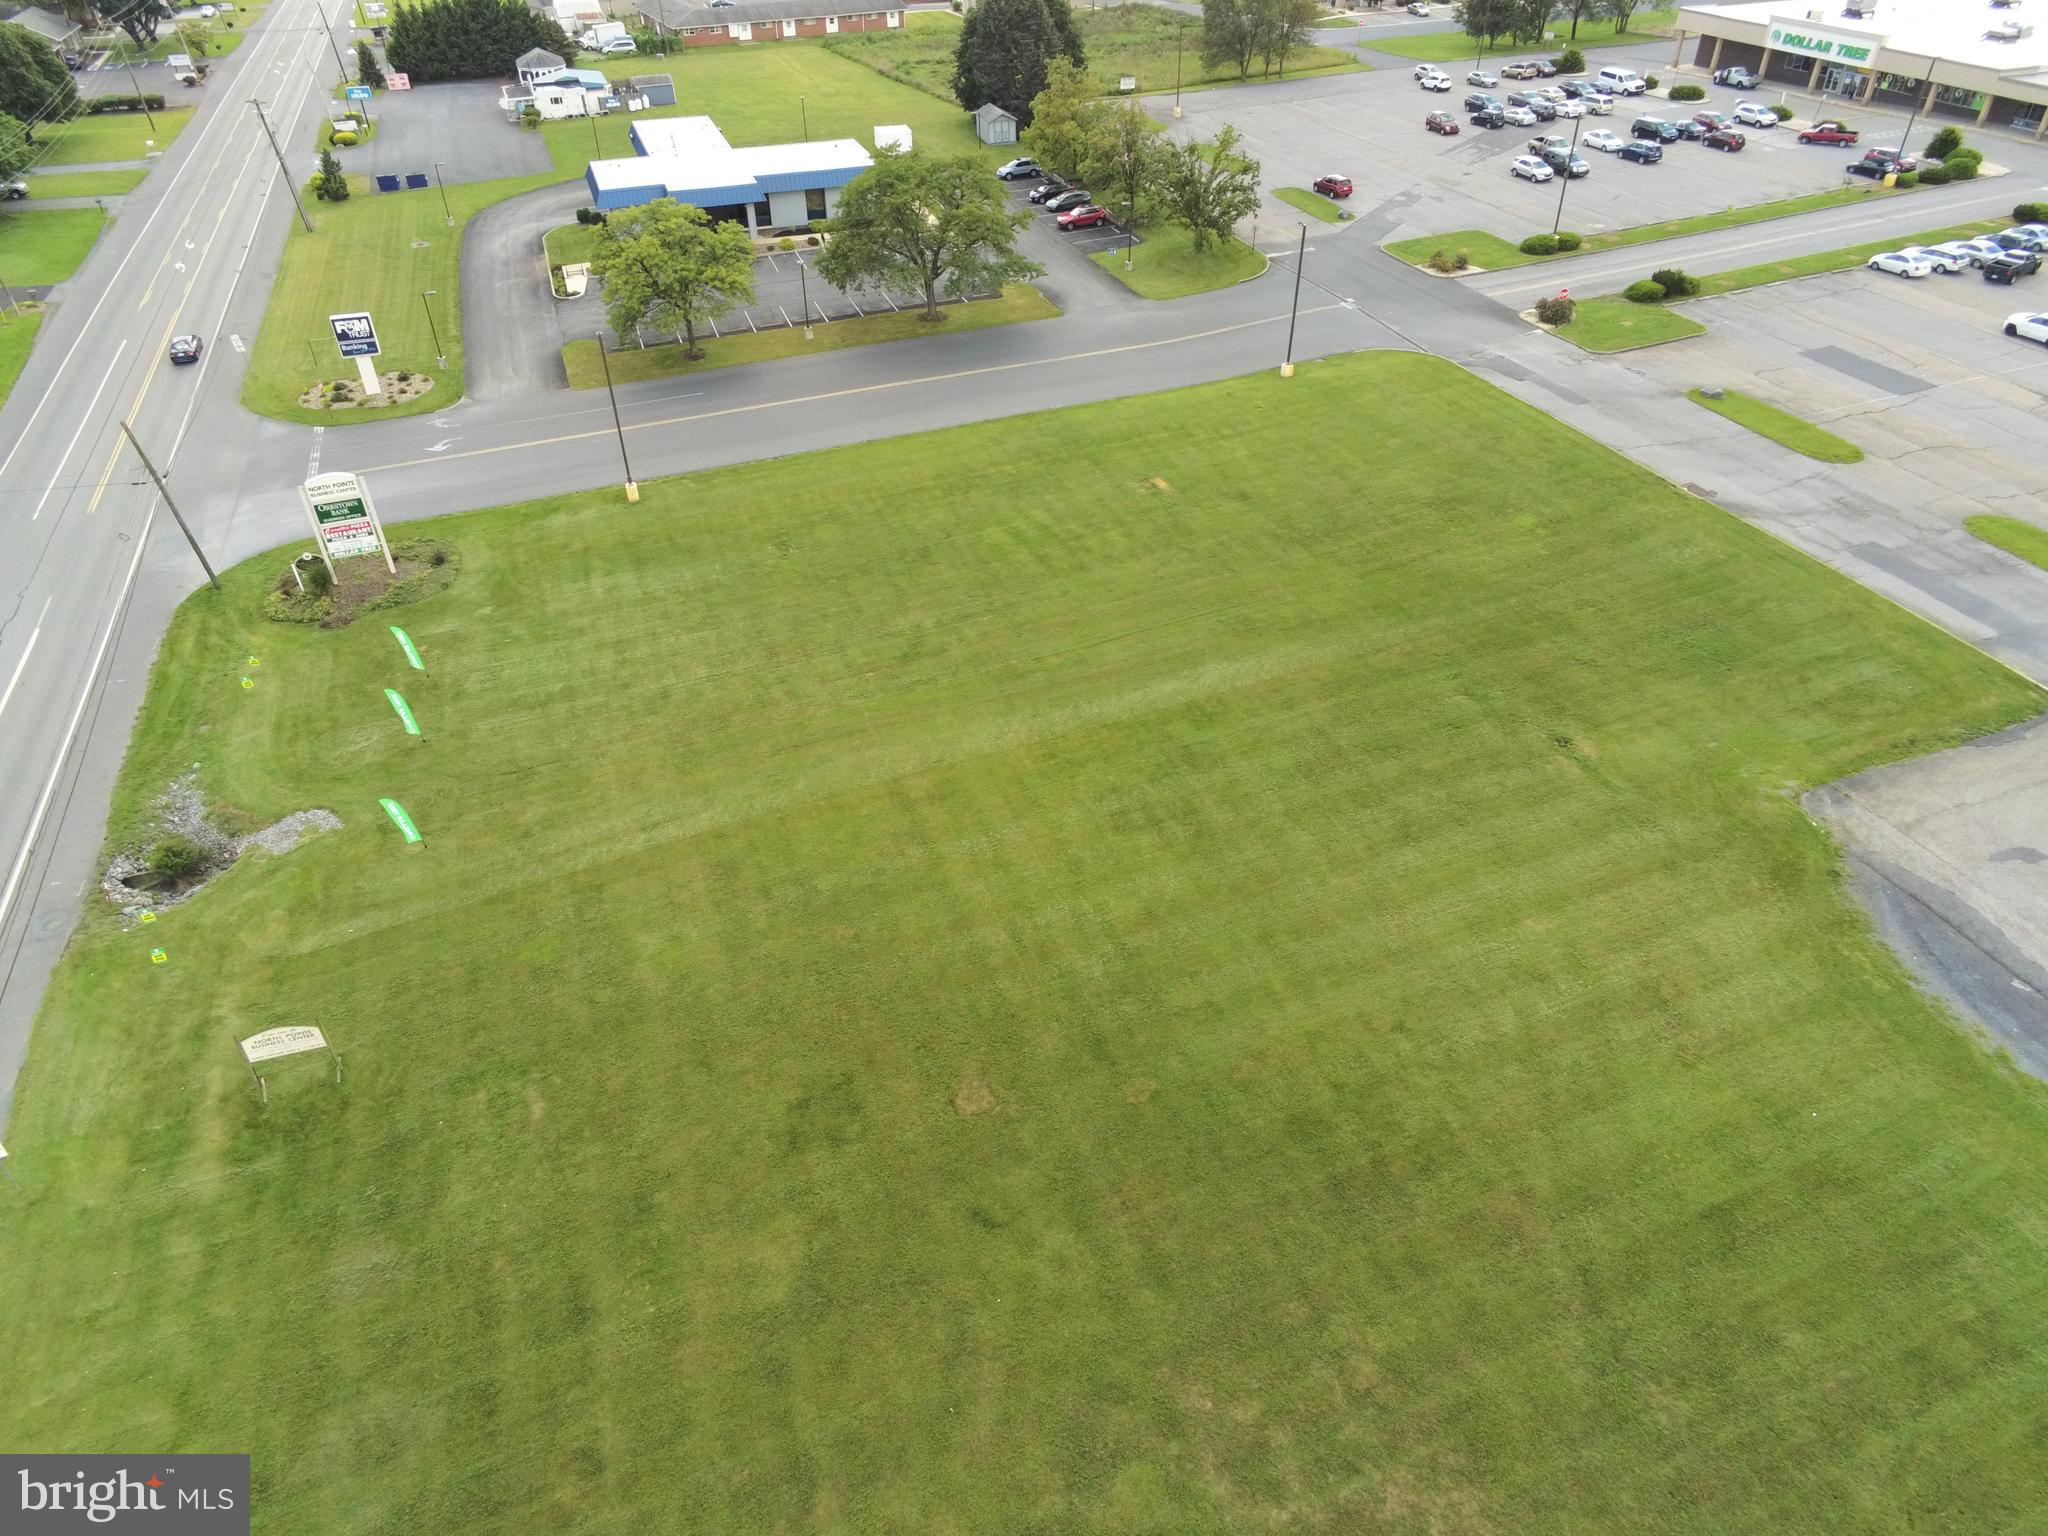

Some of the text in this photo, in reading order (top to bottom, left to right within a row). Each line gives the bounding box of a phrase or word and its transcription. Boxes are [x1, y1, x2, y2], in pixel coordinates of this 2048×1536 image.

[1782, 32, 1871, 61] DOLLAR TREE
[334, 319, 370, 333] F&M
[350, 330, 370, 338] TRUST
[308, 480, 355, 492] NORTH POINTE
[336, 486, 357, 494] CENTER
[318, 500, 359, 511] ORRSTOWN
[330, 508, 350, 516] BANK
[326, 527, 371, 538] RESTAURANT
[254, 1036, 282, 1044] NORTH
